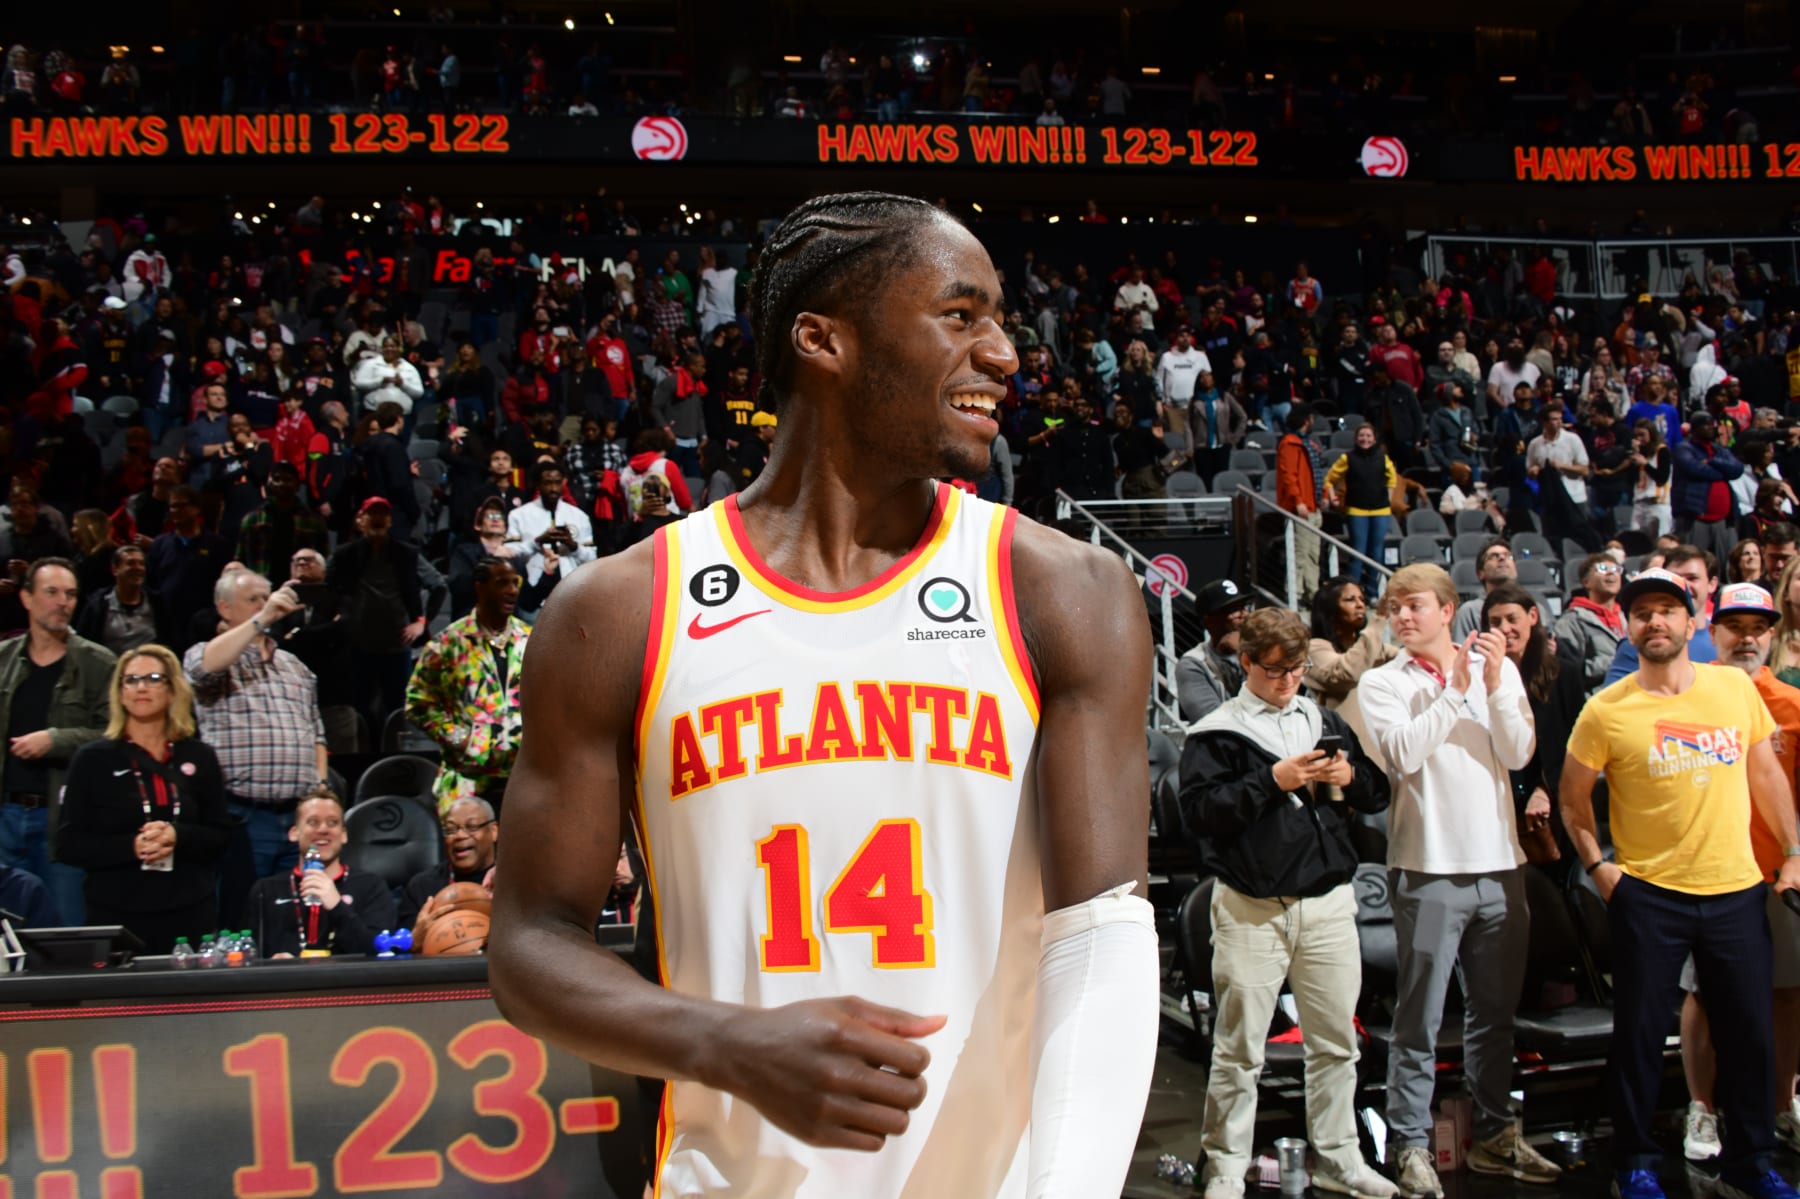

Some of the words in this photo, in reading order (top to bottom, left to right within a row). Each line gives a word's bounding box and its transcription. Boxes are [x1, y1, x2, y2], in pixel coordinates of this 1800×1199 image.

[11, 115, 168, 157] HAWKS
[179, 113, 311, 155] WIN!!!
[329, 113, 510, 153] 123-122
[817, 124, 960, 163] HAWKS
[968, 125, 1087, 164] WIN!!!
[1101, 126, 1259, 165] 123-122
[1515, 145, 1637, 181] HAWKS
[1644, 143, 1751, 180] WIN!!!
[703, 570, 728, 602] 6
[906, 628, 986, 641] sharecare
[669, 680, 1013, 801] ATLANTA
[1648, 739, 1692, 764] ALL
[1696, 726, 1737, 752] DAY
[1648, 752, 1718, 777] RUNNING
[755, 818, 937, 973] 14
[223, 1019, 619, 1199] 123-
